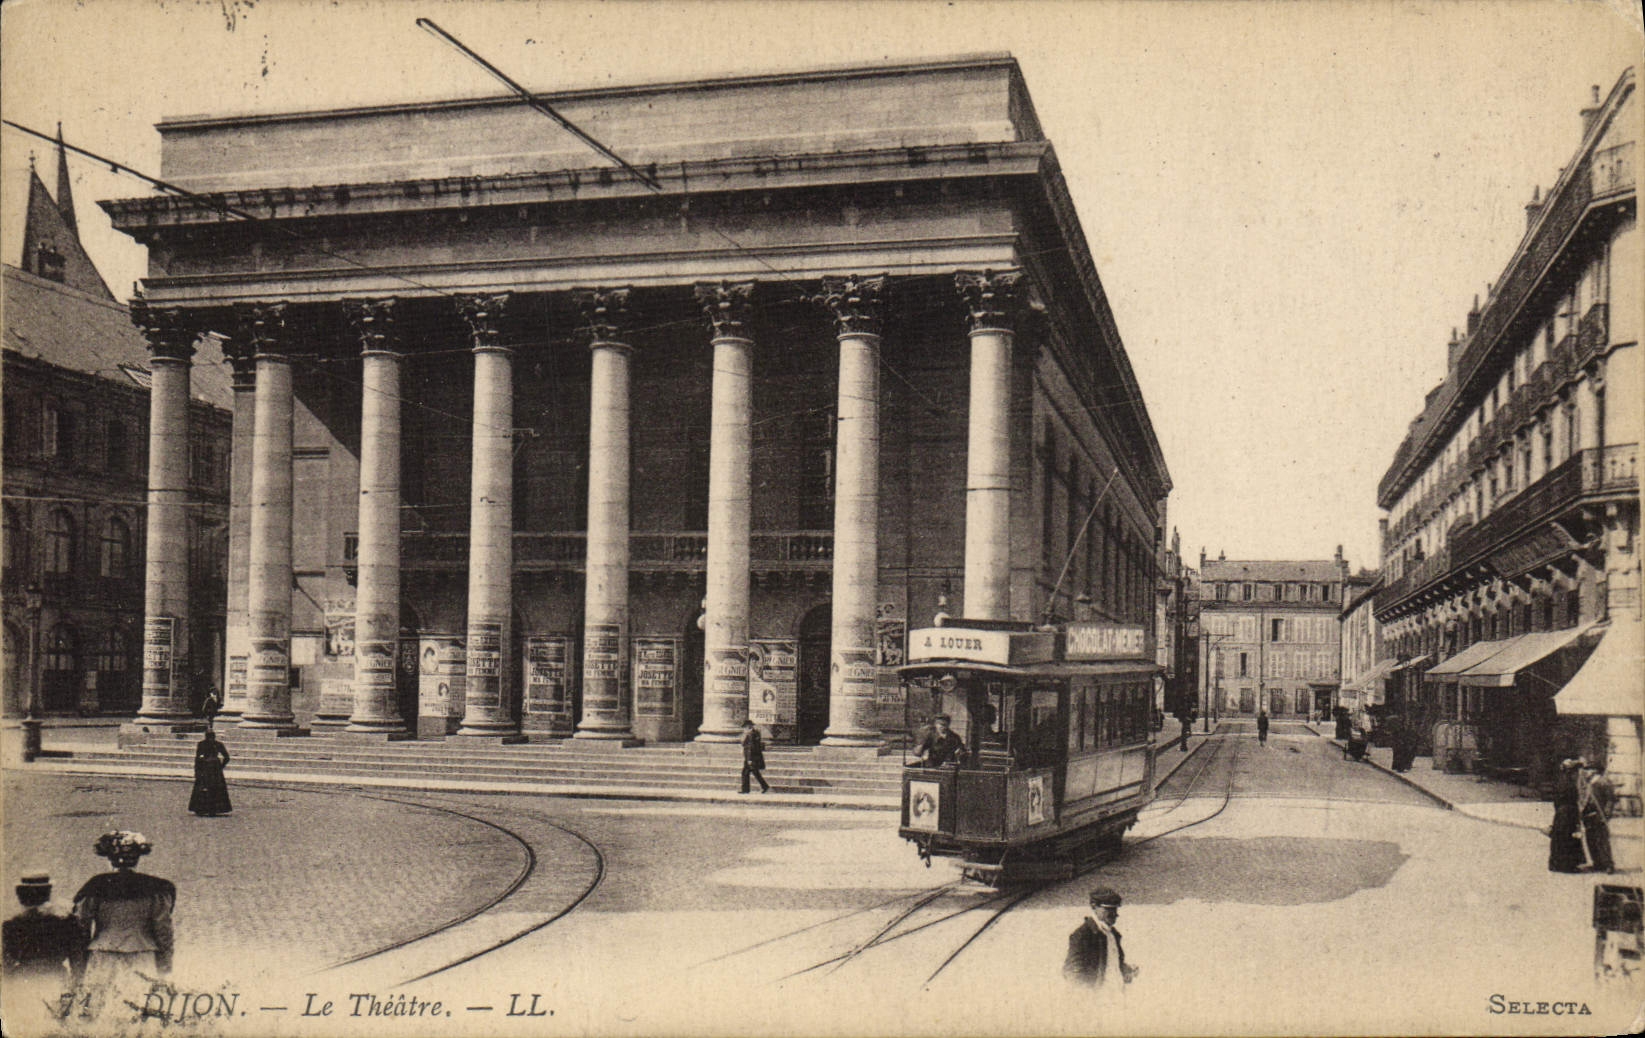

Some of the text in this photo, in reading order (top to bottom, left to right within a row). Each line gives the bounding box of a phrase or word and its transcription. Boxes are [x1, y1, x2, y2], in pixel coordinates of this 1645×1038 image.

[924, 636, 983, 651] A LOUER
[639, 670, 674, 680] JOSETTE
